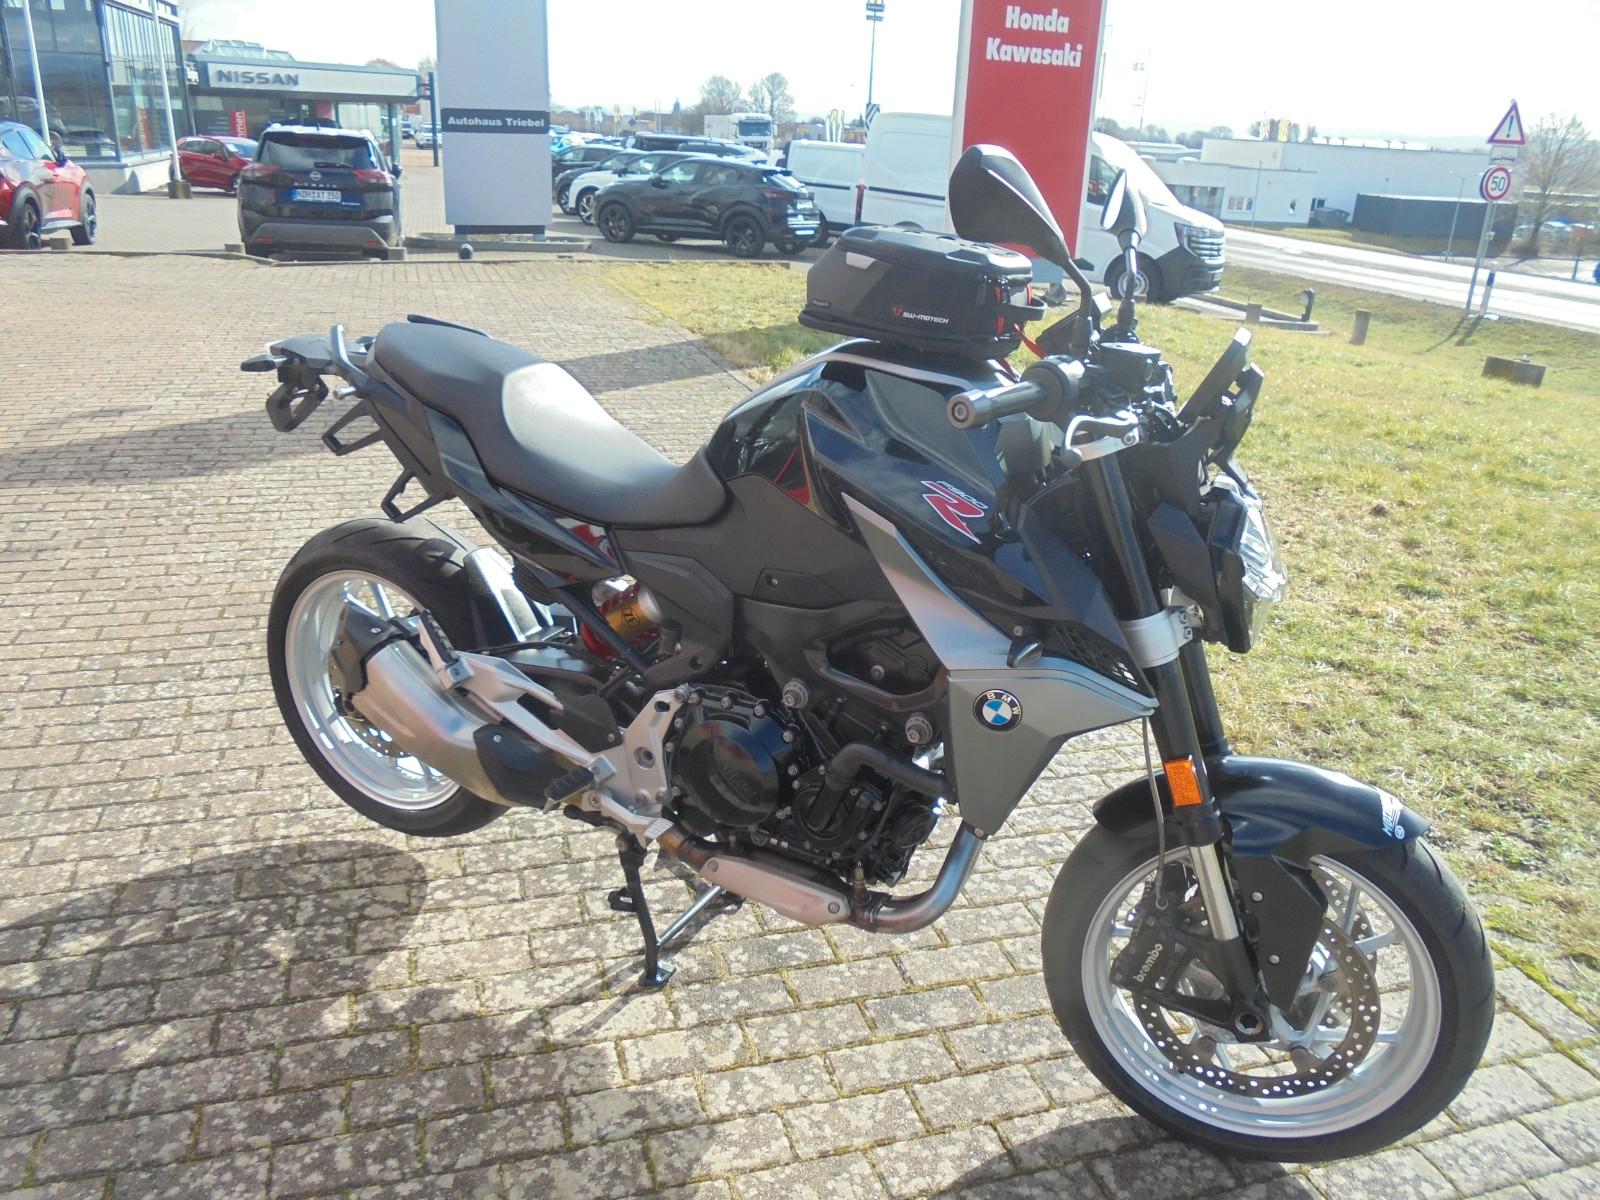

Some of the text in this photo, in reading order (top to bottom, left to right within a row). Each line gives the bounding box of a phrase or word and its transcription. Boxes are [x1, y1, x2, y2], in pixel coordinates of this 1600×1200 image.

[1006, 5, 1069, 33] Honda
[986, 37, 1083, 67] Kawasaki
[216, 70, 299, 86] NISSAN
[447, 116, 545, 127] Autohaus Triebel
[1491, 176, 1506, 192] 50
[902, 311, 949, 324] SW-MOTECH
[920, 480, 985, 544] R
[986, 691, 1022, 715] BMW
[1133, 943, 1164, 983] brembo
